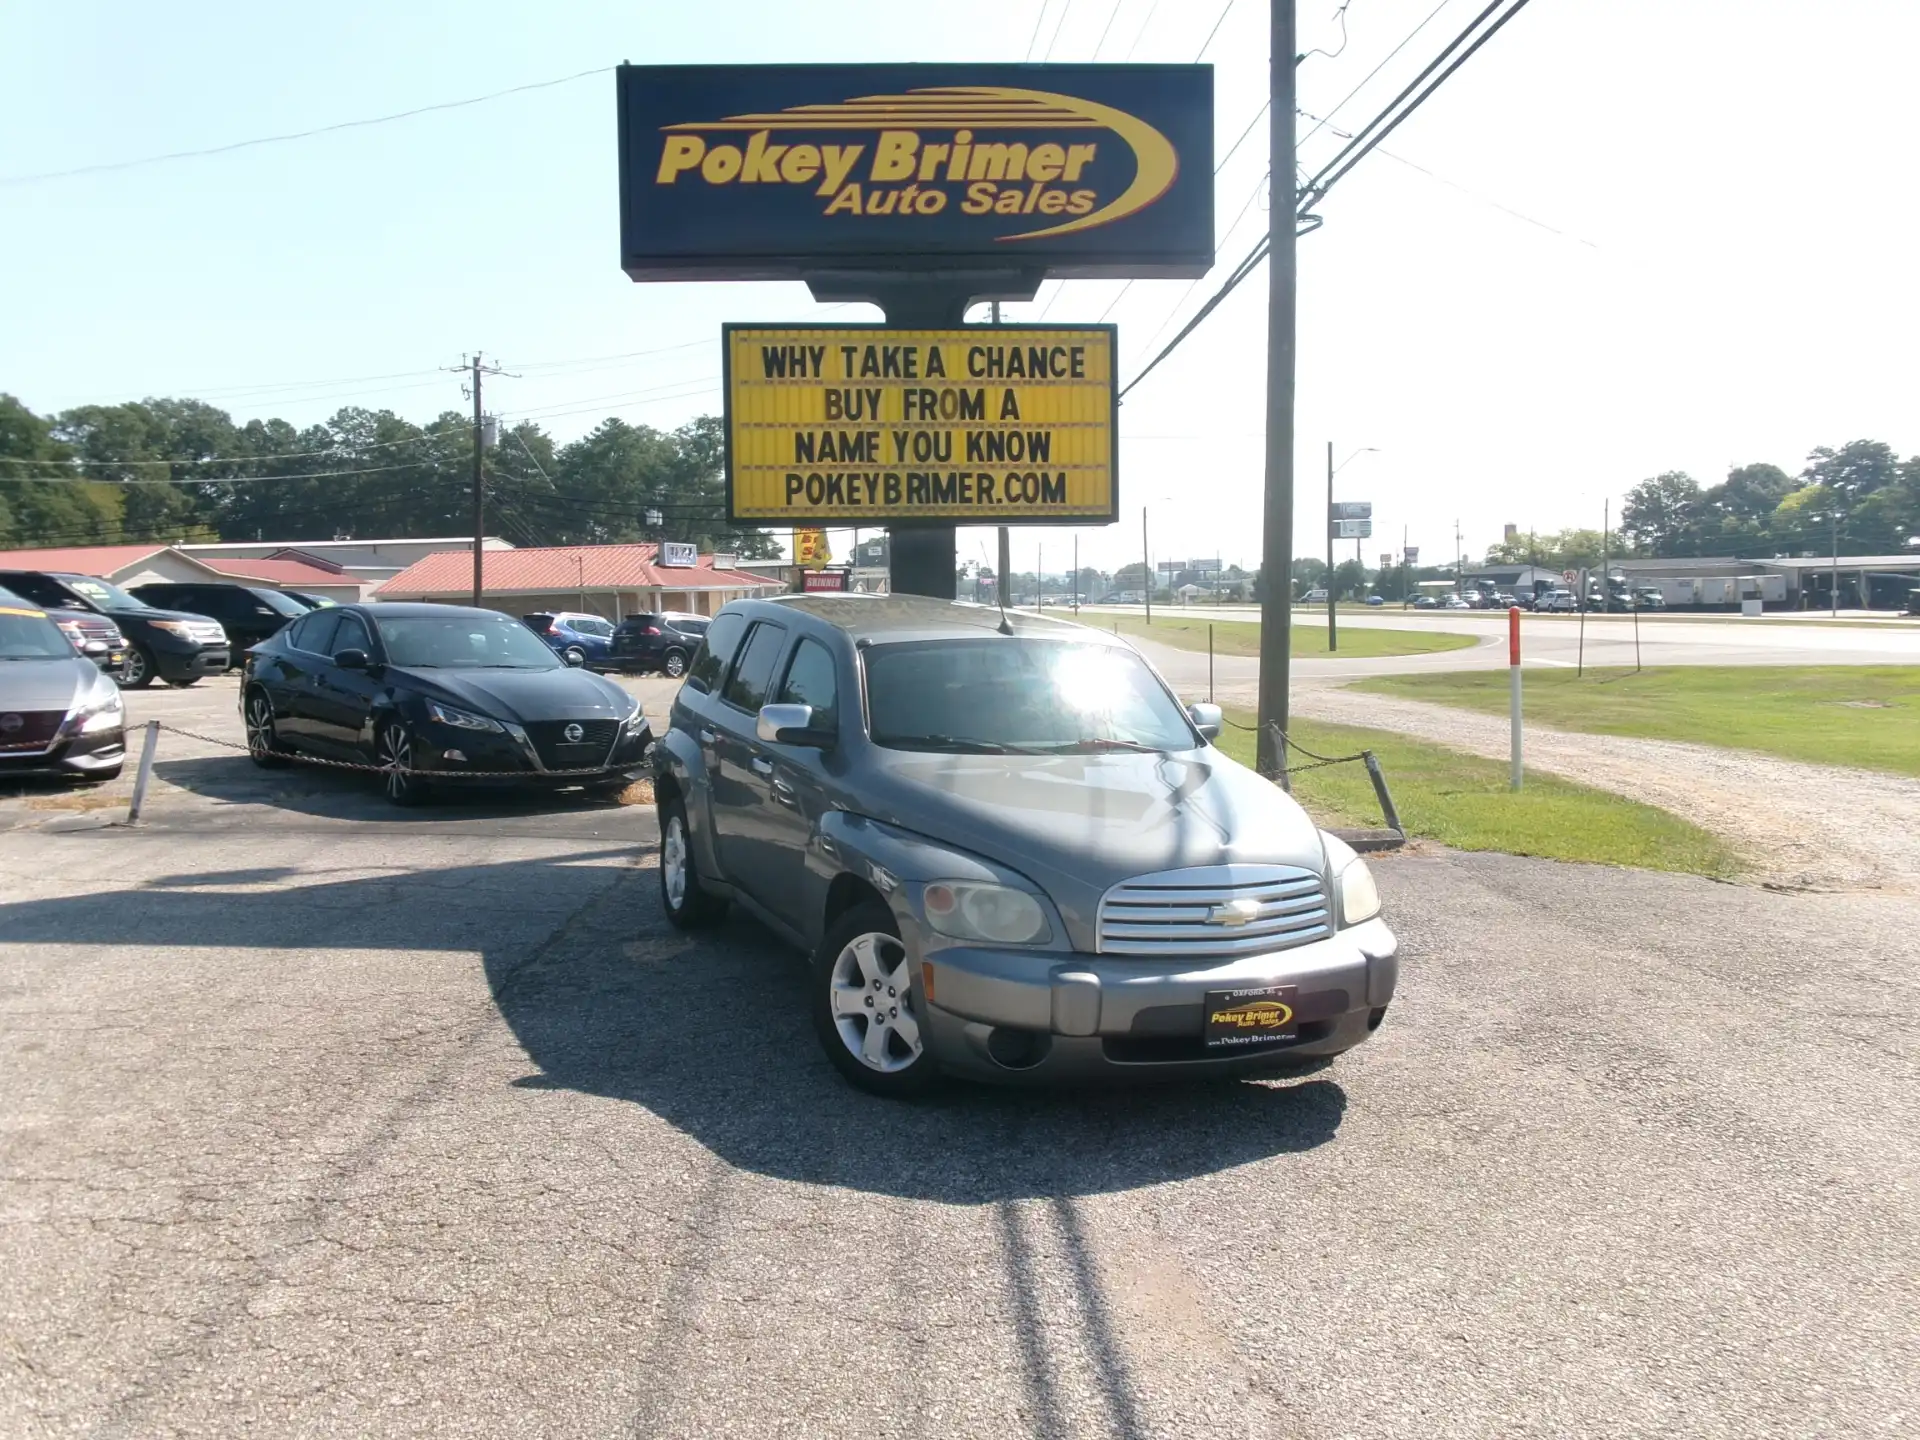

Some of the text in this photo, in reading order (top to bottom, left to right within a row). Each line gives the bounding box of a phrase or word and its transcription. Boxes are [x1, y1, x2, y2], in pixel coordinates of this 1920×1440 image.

[656, 130, 1096, 196] Pokey Brimer
[823, 181, 1096, 216] Auto Sales
[762, 345, 1085, 379] WHY TAKE A CHANCE
[825, 388, 1020, 420] BUY FROM A
[795, 431, 1051, 463] NAME YOU KNOW
[785, 472, 1067, 505] POKEYBRIMER.COM
[806, 577, 841, 588] SKINNER
[1211, 1010, 1280, 1024] Pokey Brimer
